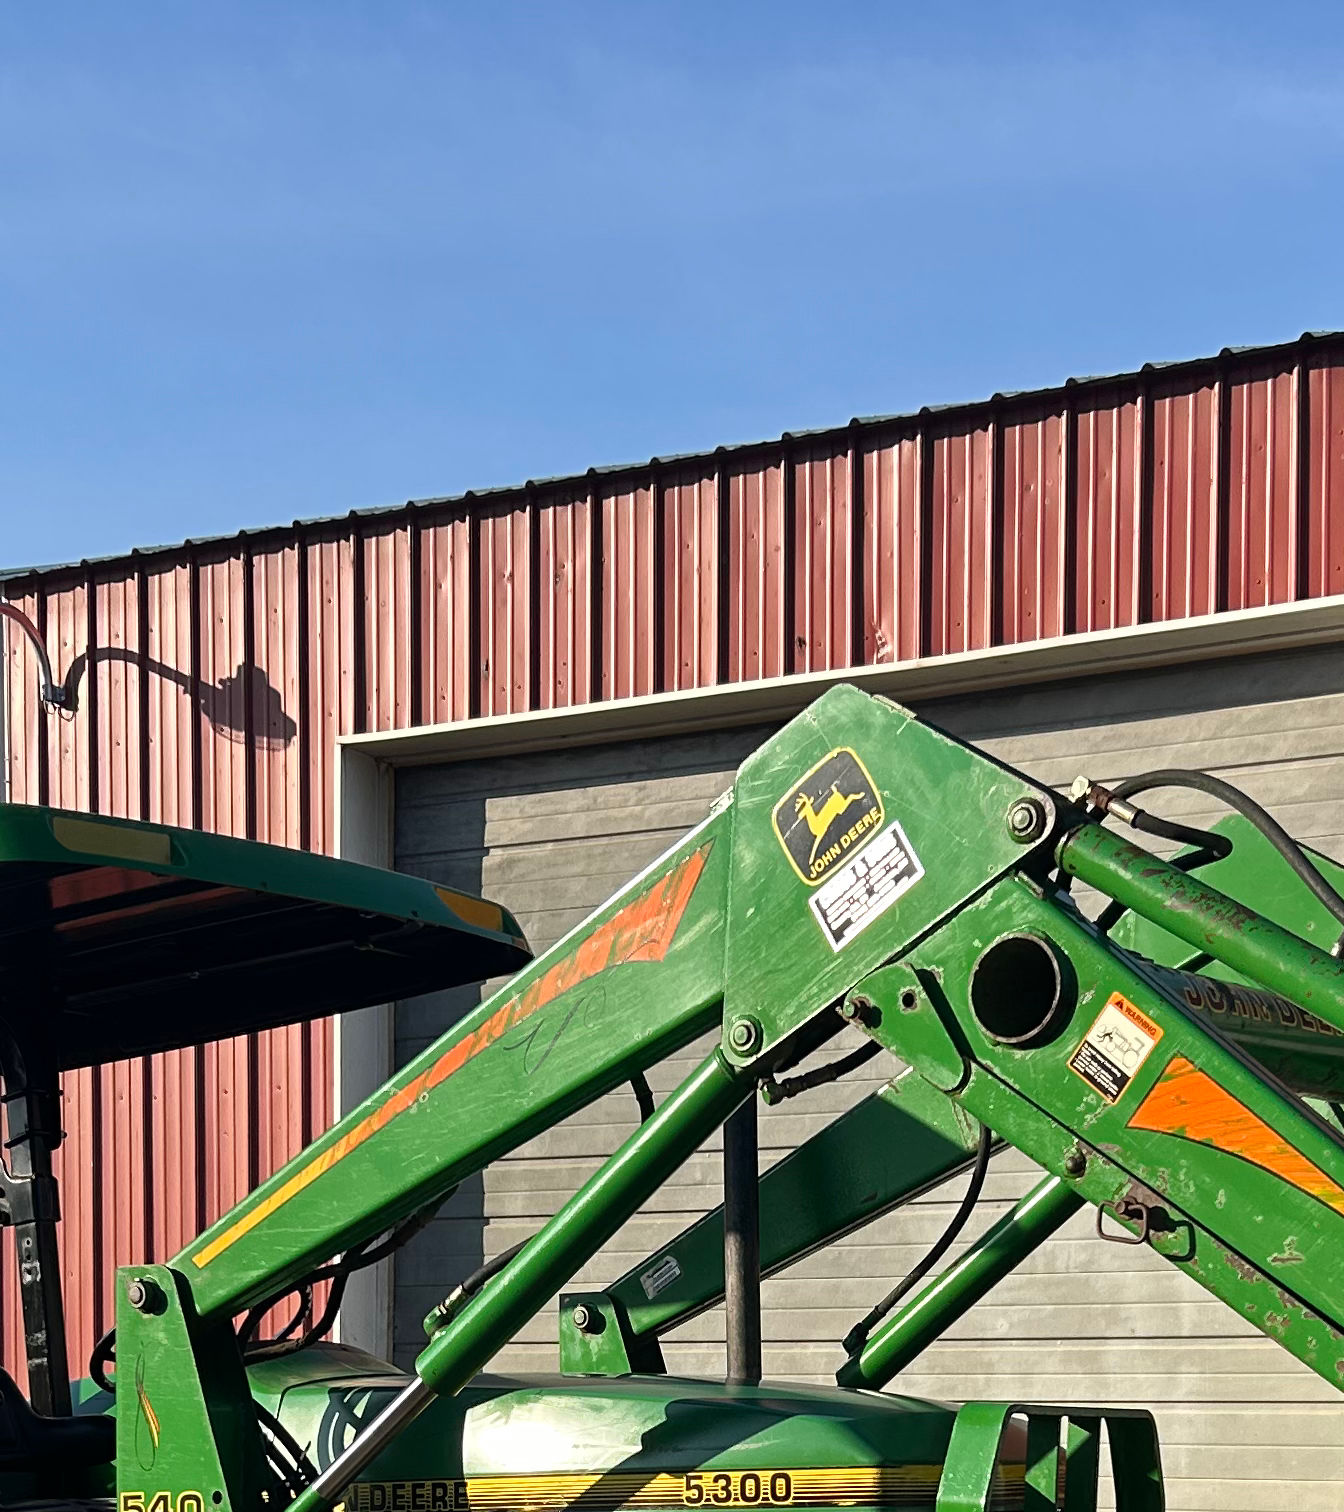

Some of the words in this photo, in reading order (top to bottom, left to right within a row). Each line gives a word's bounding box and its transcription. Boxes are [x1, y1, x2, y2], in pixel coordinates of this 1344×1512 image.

[809, 845, 842, 879] JOHN
[839, 806, 883, 850] DEERE
[1125, 1006, 1157, 1036] WARNING
[369, 1480, 470, 1512] DEERE
[683, 1472, 793, 1507] 5300
